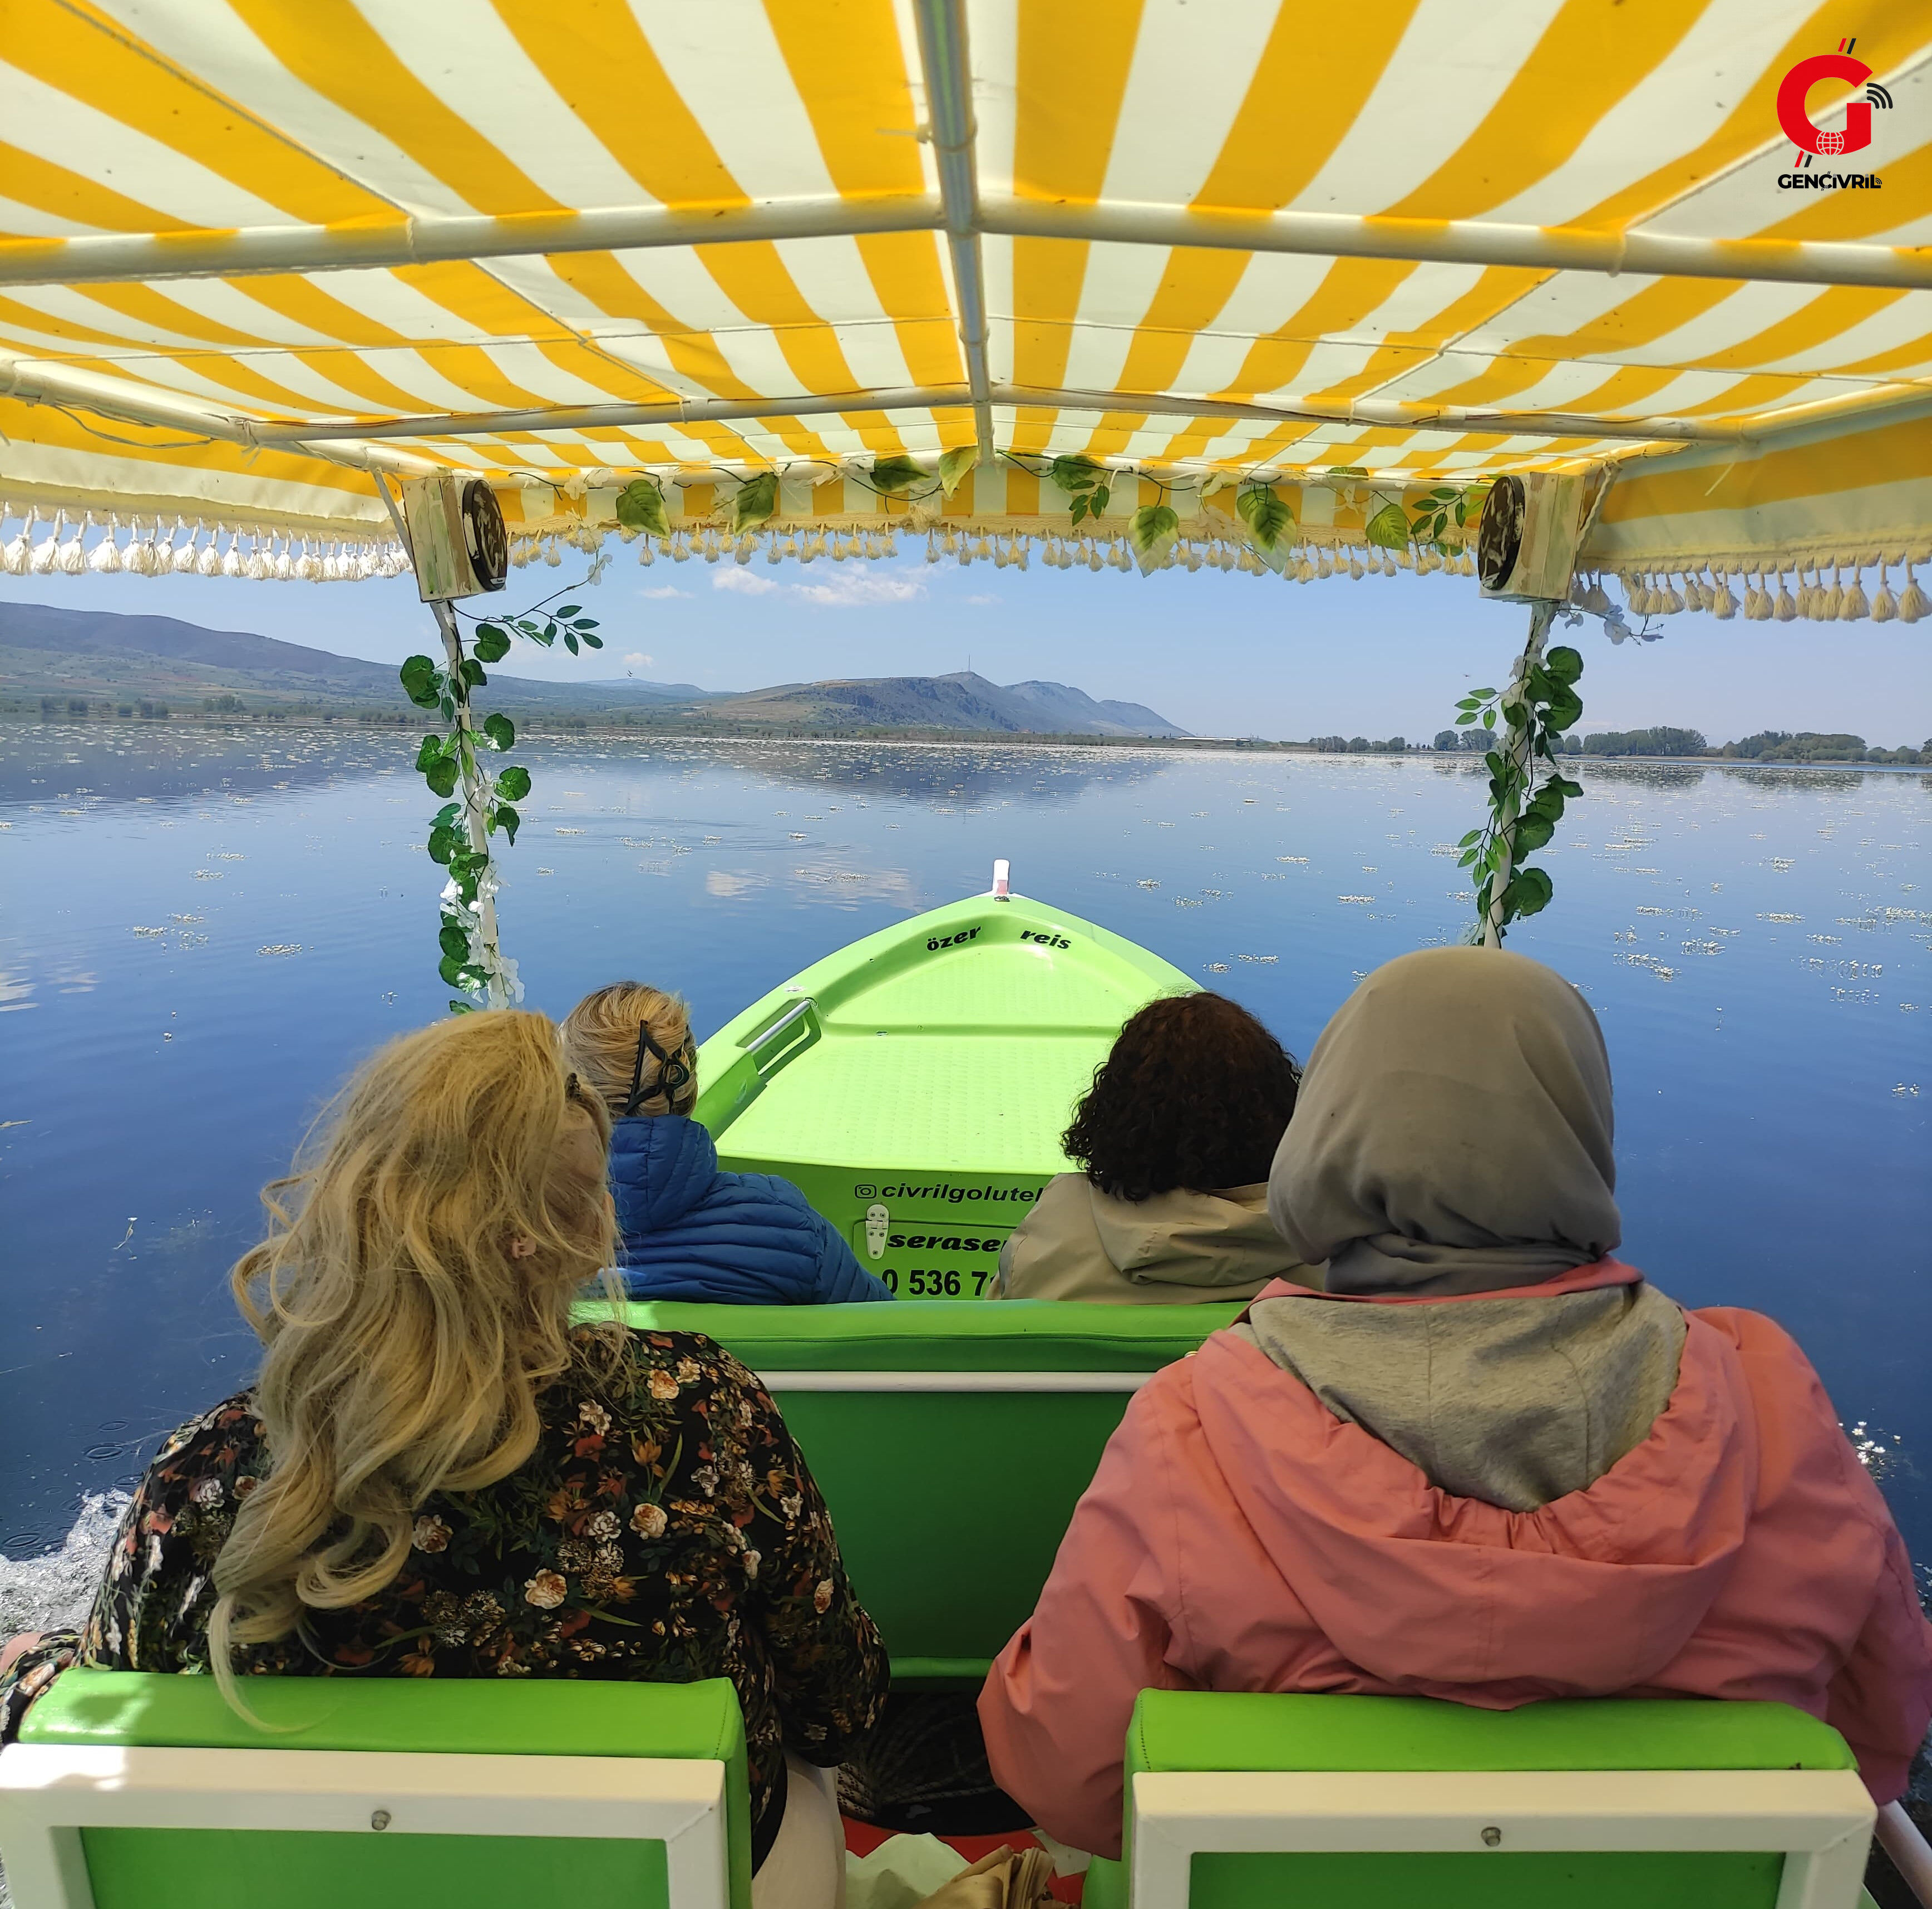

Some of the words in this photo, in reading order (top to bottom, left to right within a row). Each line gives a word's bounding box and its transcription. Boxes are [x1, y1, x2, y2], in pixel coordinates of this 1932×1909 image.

[926, 926, 981, 951] özer
[1019, 929, 1071, 949] reis
[881, 1268, 899, 1296] 0
[908, 1270, 961, 1296] 536
